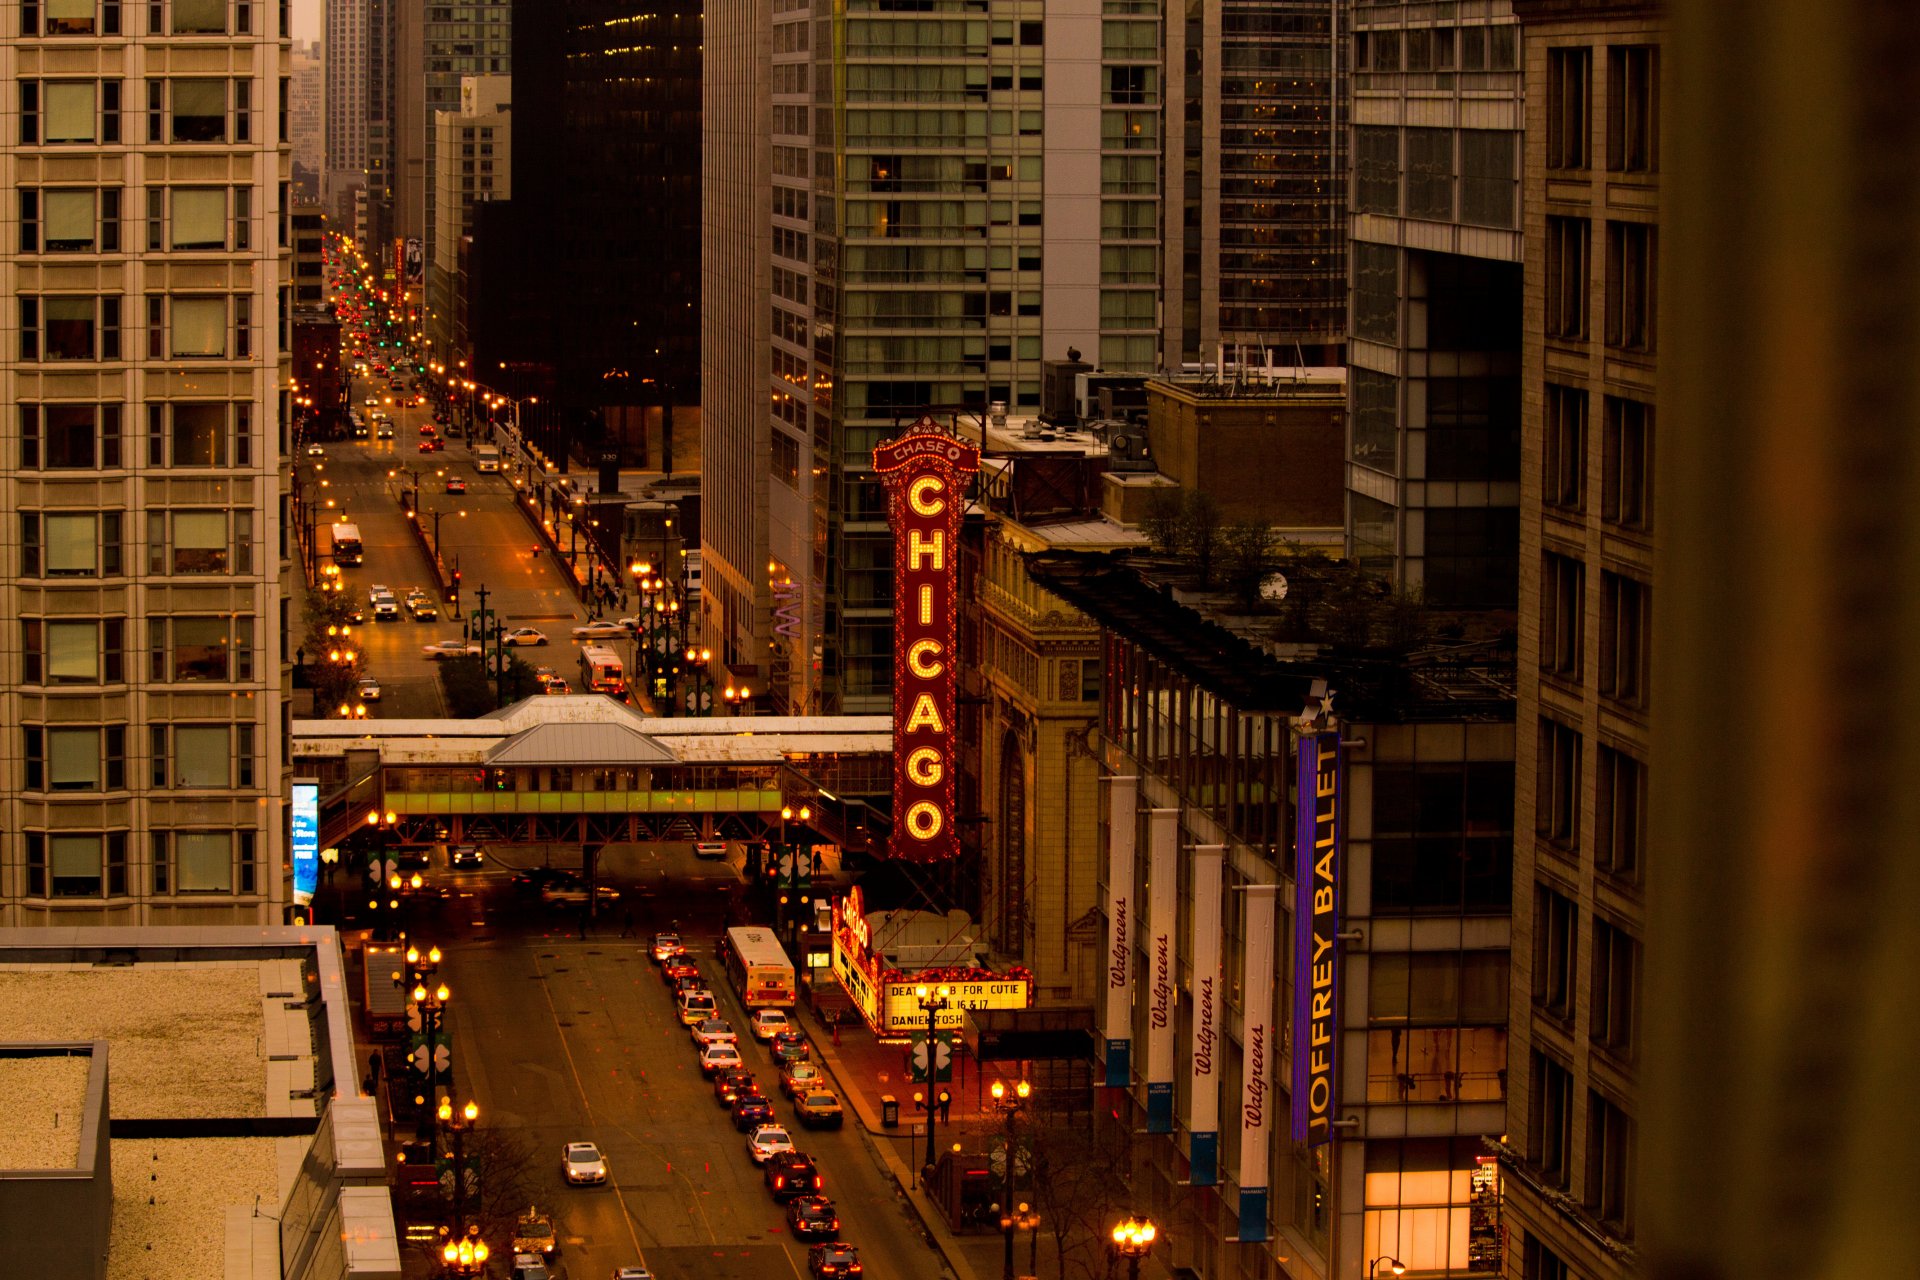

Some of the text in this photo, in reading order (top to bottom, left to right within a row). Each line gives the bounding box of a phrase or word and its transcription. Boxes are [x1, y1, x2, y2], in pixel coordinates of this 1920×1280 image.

[893, 440, 946, 460] CHASE
[904, 475, 946, 841] CHICAGO
[1110, 897, 1130, 989] Walgreens
[1151, 934, 1172, 1030] Walgreens
[1310, 743, 1336, 1134] JOFFREY BALLET
[892, 985, 1019, 996] DEAT CB FOR CUTIE
[892, 1015, 963, 1025] DANIEL TOSH
[957, 1000, 966, 1009] 16
[979, 1000, 988, 1009] 17
[1194, 976, 1217, 1077] Walgreens
[1244, 1024, 1268, 1129] Walgreens
